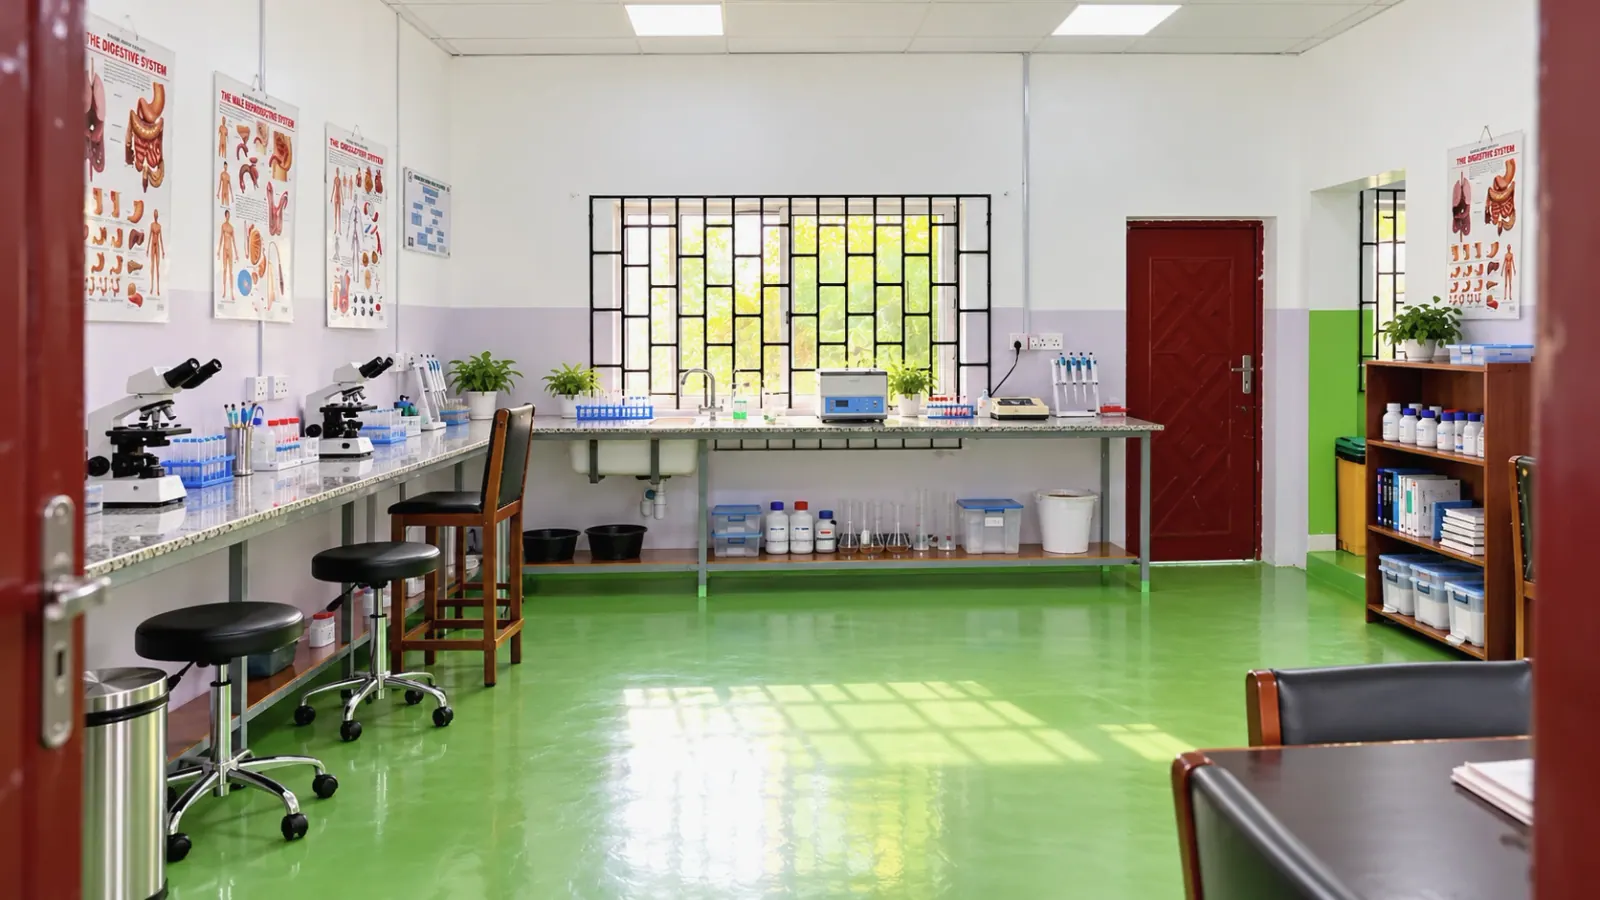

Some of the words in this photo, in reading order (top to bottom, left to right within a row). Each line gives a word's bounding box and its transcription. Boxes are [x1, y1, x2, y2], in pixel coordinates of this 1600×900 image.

[87, 32, 101, 49] THE
[102, 39, 140, 65] DIGESTIVE
[141, 56, 167, 76] SYSTEM
[221, 90, 232, 103] THE
[330, 138, 340, 148] THE
[1456, 157, 1467, 165] THE
[1494, 144, 1515, 156] SYSTEM
